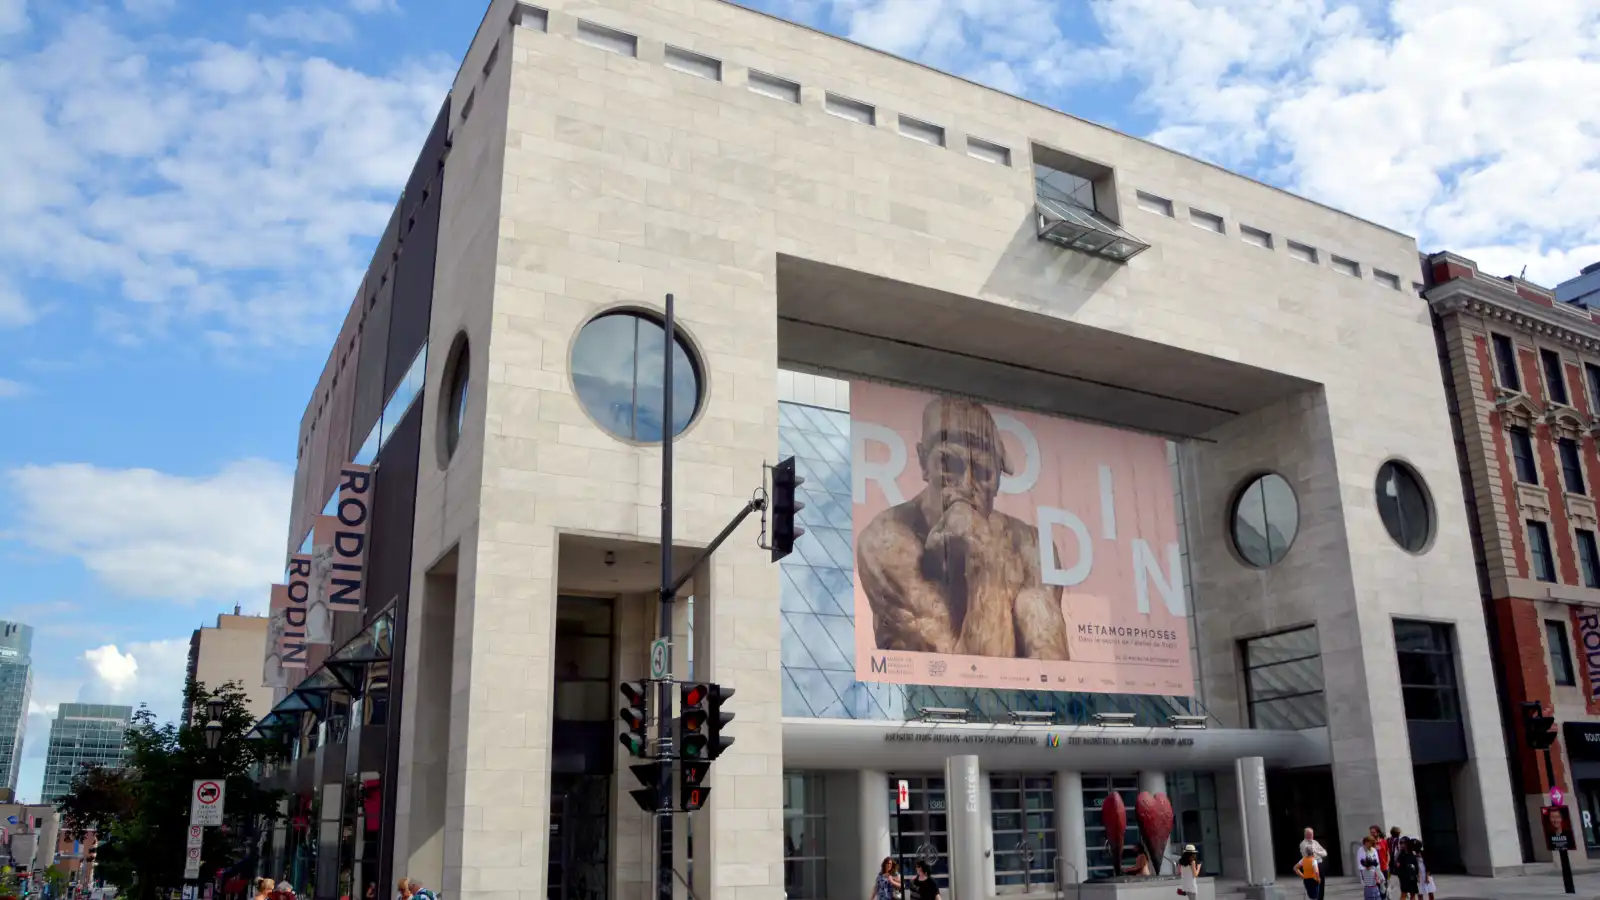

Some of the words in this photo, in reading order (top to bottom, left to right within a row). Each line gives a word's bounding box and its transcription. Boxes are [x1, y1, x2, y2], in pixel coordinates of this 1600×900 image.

[330, 469, 369, 604] RODIN
[282, 558, 311, 662] RODIN
[1078, 622, 1177, 640] MÉTAMORPHOSES
[871, 656, 887, 673] M
[964, 765, 977, 812] Entrée
